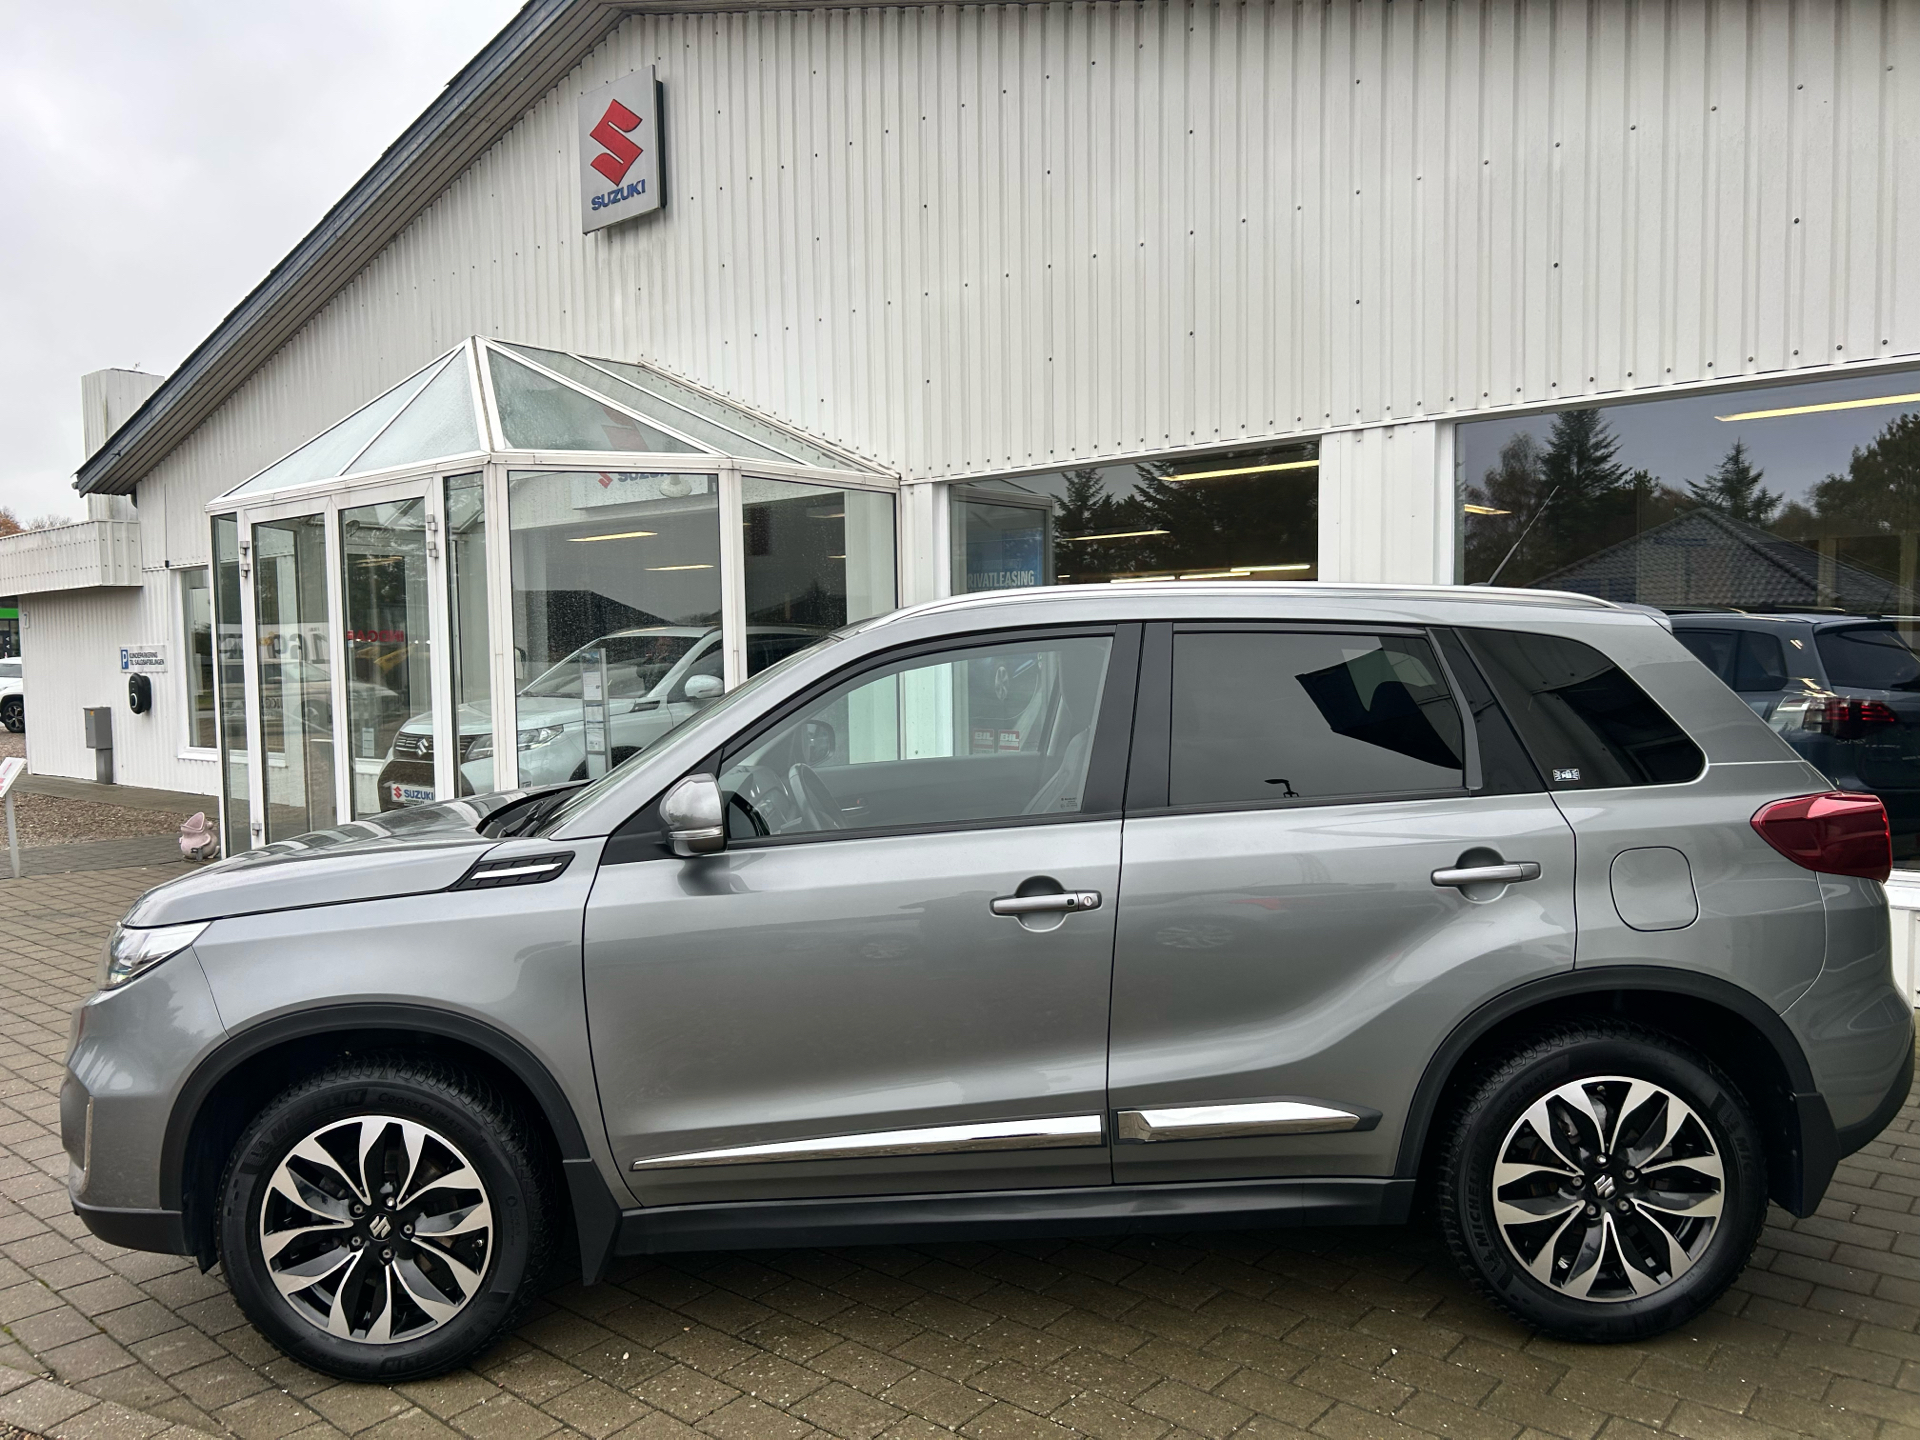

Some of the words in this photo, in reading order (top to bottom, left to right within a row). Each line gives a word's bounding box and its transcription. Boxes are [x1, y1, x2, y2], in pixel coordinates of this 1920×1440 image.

[591, 179, 646, 211] SUZUKI
[967, 570, 1035, 588] RIVATLEASING
[1000, 732, 1020, 742] BIL
[403, 789, 434, 801] SUZUKI
